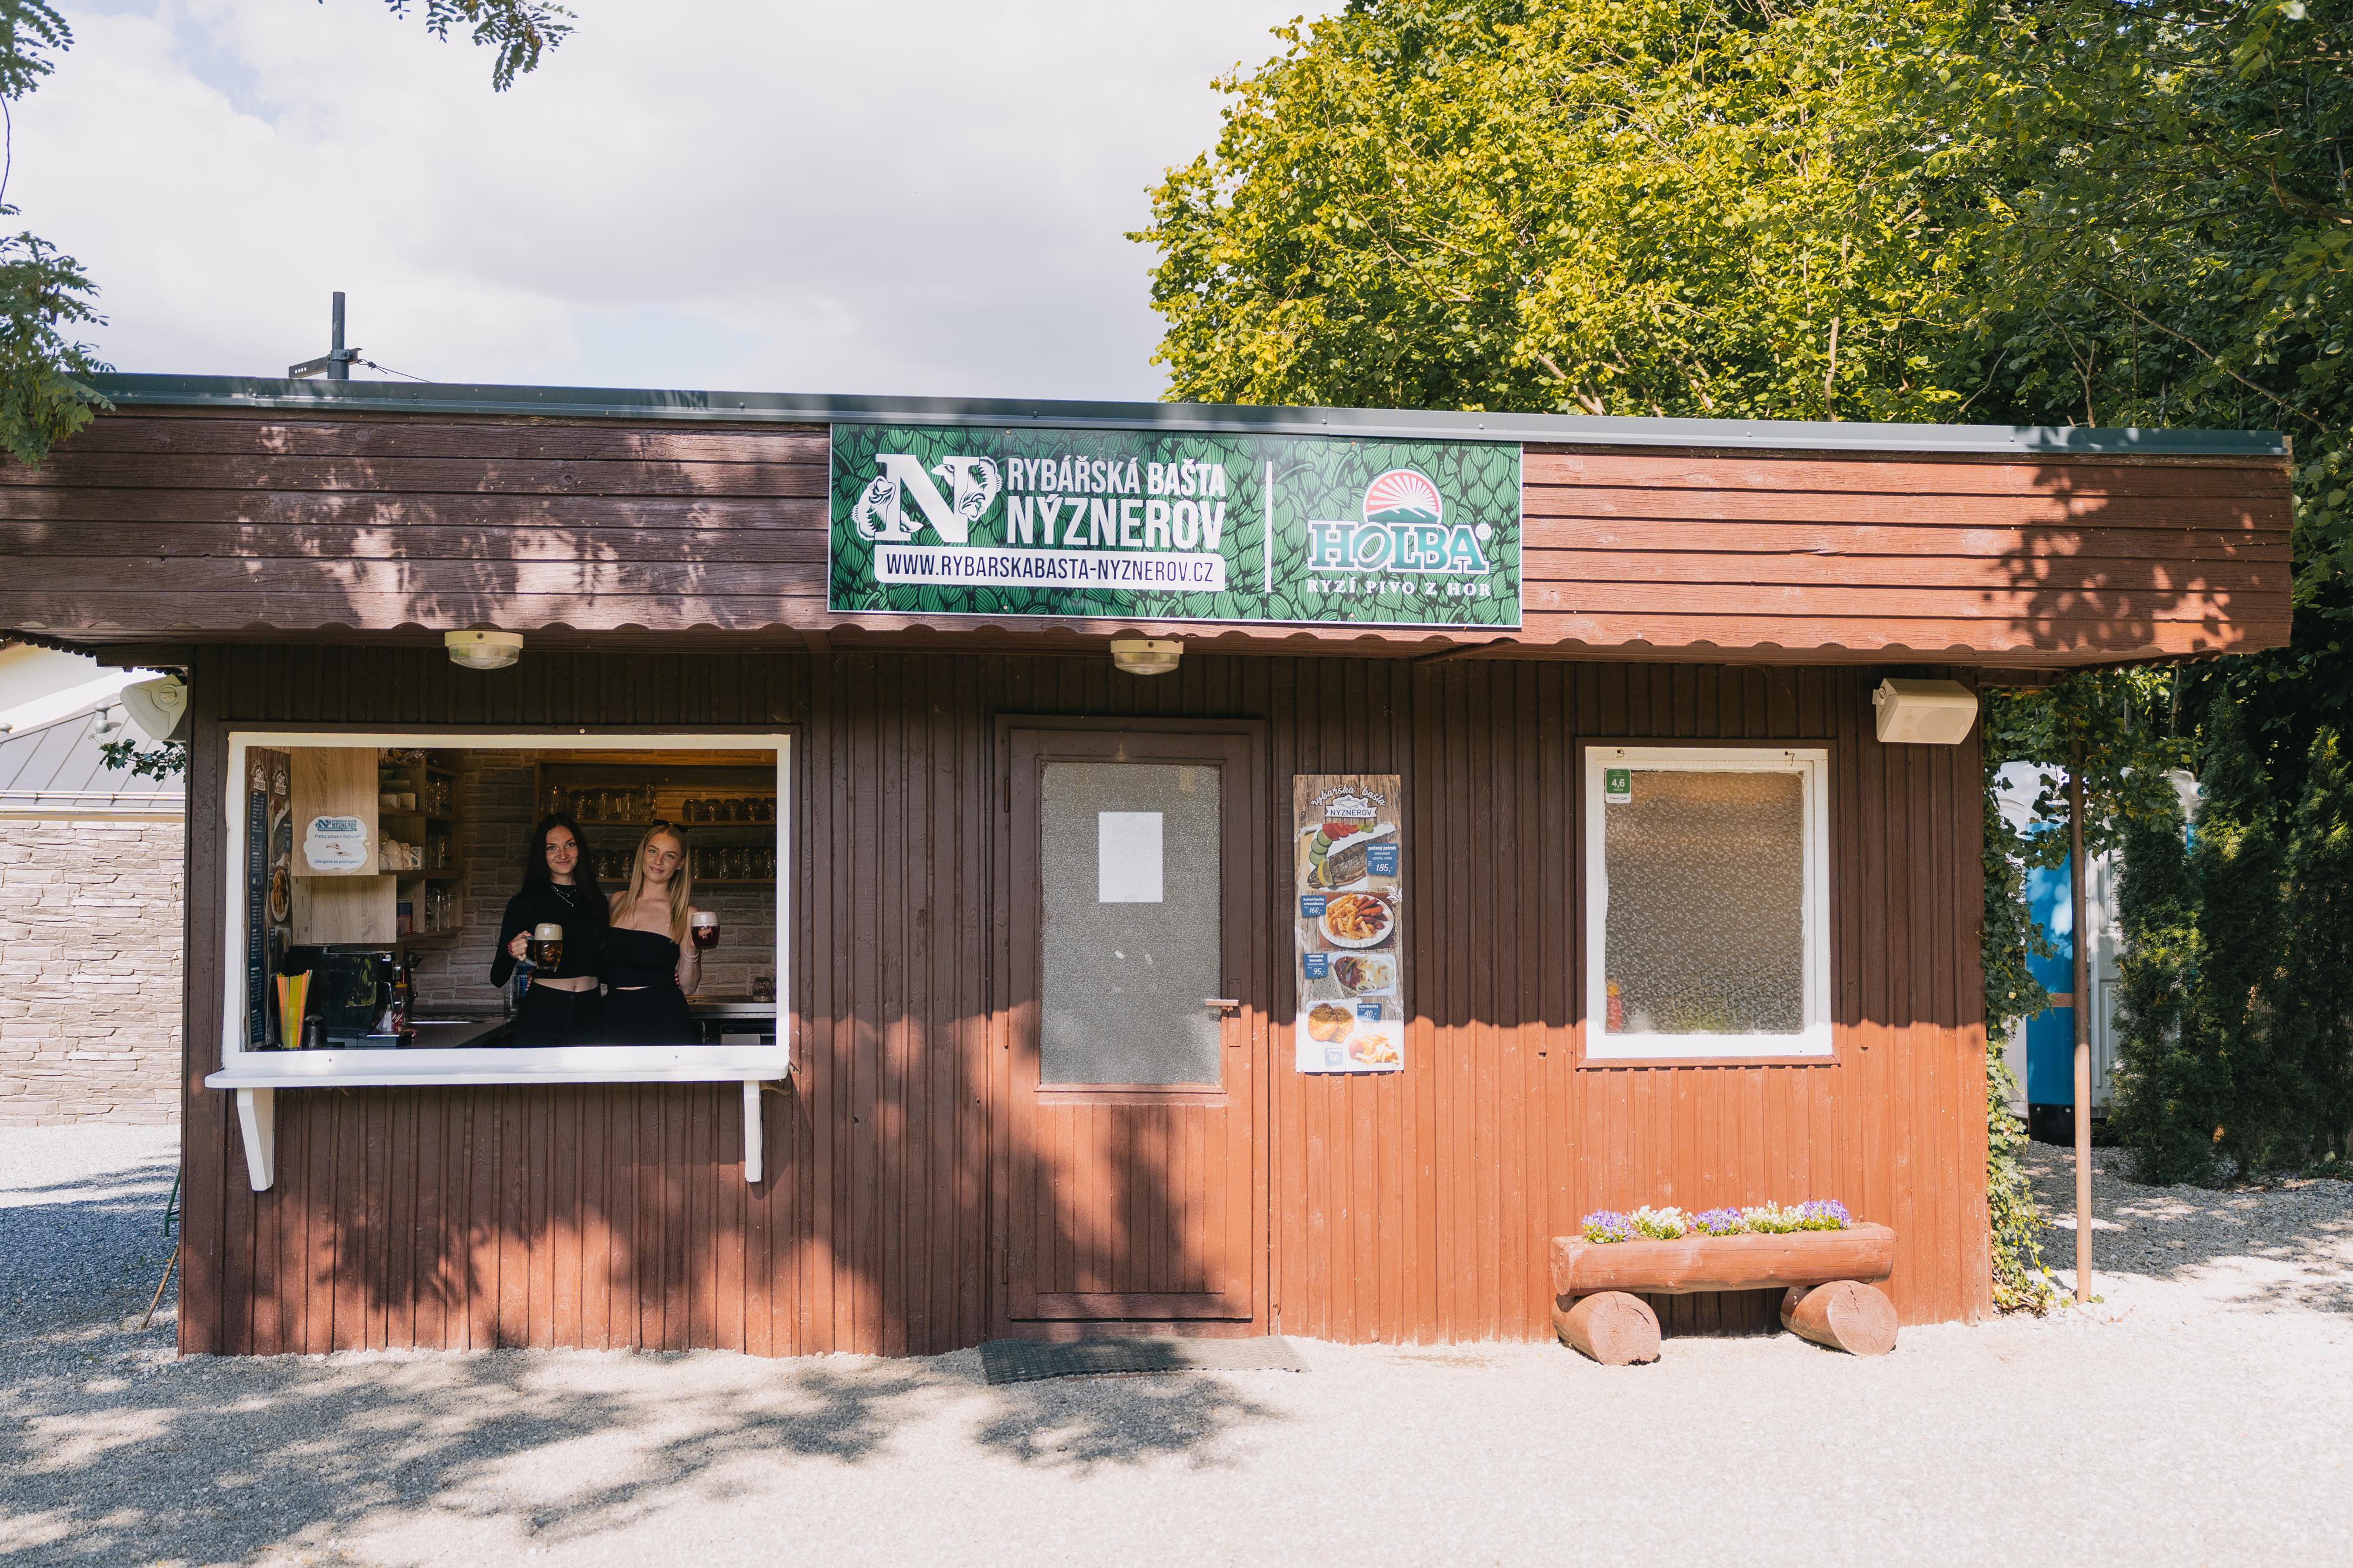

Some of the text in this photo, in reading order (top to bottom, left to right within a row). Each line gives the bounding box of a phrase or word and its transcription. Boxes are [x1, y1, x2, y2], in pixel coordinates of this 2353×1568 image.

[1007, 455, 1226, 497] RYBÁŘSKÁ BAŠTA
[1006, 494, 1227, 549] NÝZNEROV
[1307, 519, 1491, 575] HOLBA
[886, 553, 1214, 582] WWW.RYBARSKABASTA-NYZNEROV.CZ
[1307, 576, 1492, 597] RYZÍ PIVO Z HOR
[1611, 778, 1625, 789] 4,6
[1362, 786, 1386, 806] bašta
[1330, 808, 1372, 816] NÝZNEROV
[1376, 863, 1394, 873] 185,-
[1309, 907, 1322, 915] 160,-
[1312, 968, 1325, 976] 95,-
[1364, 1010, 1377, 1019] 40,-
